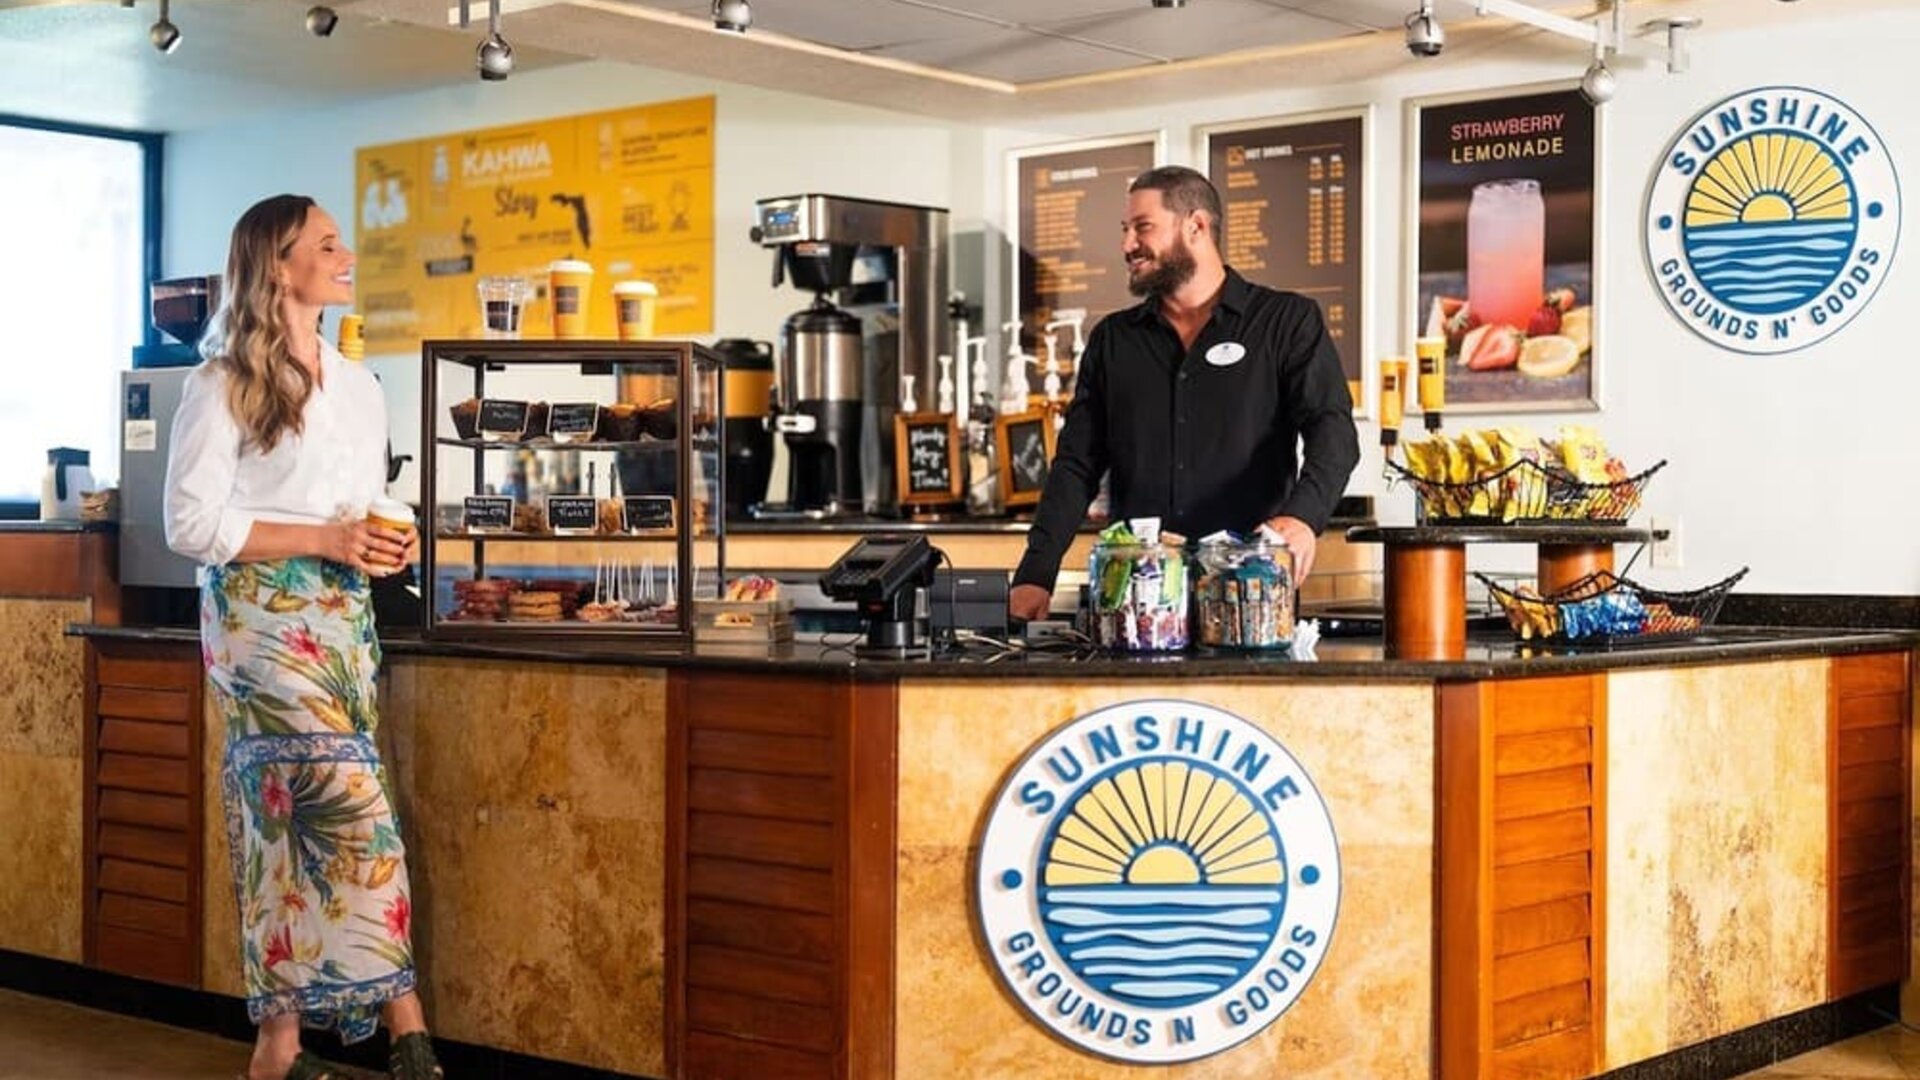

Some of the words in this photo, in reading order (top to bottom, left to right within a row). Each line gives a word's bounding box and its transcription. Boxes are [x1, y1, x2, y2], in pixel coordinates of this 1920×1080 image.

[461, 141, 553, 178] KAHWA
[1450, 113, 1566, 141] STRAWBERRY
[1451, 137, 1565, 164] LEMONADE
[1672, 97, 1870, 176] SUNSHINE
[1661, 259, 1758, 340] GROUNDS
[1810, 248, 1880, 326] GOODS
[1020, 716, 1301, 815] SUNSHINE
[1007, 931, 1151, 1045] GROUNDS
[1173, 1016, 1195, 1043] N
[1225, 925, 1317, 1026] GOODS
